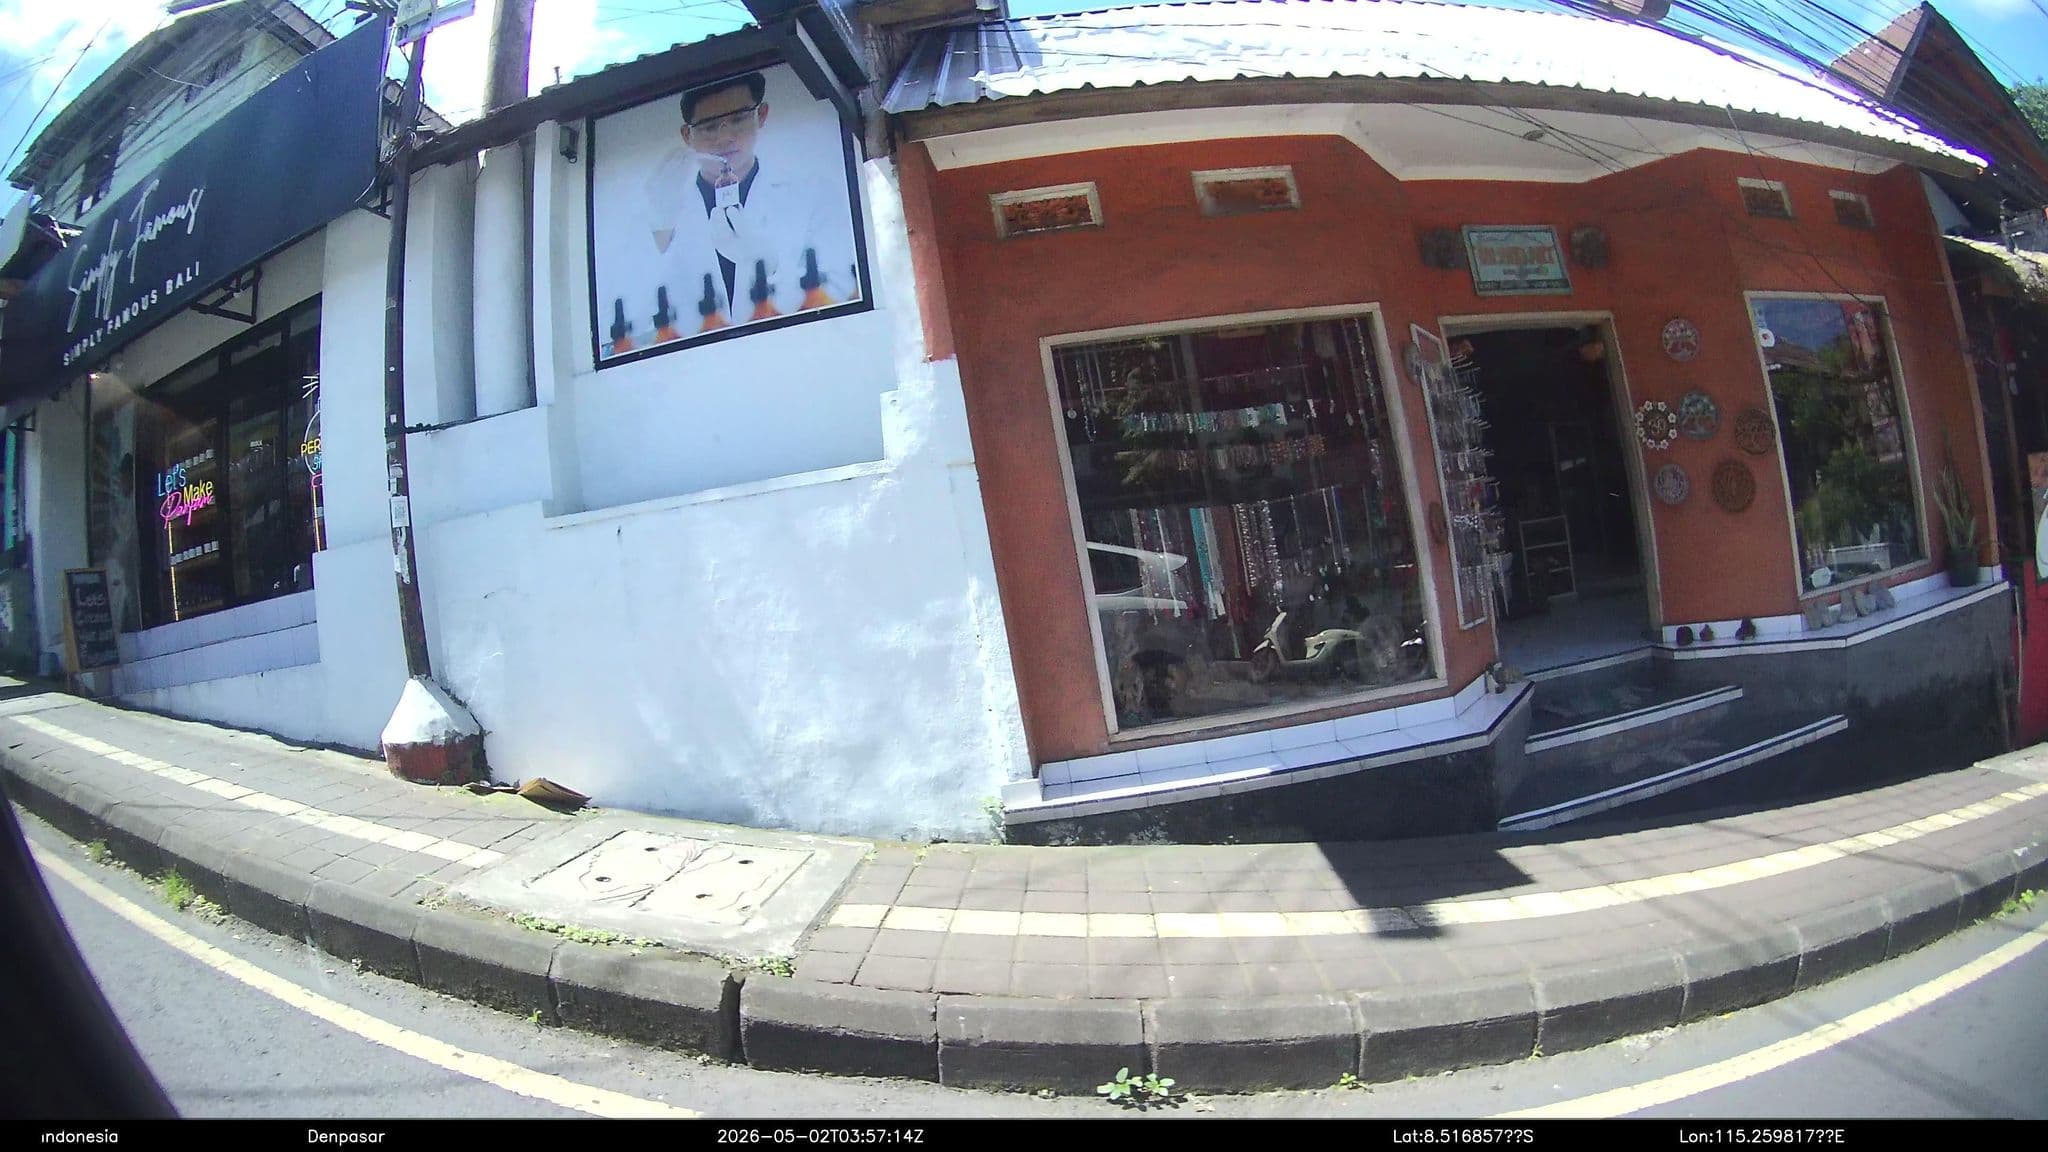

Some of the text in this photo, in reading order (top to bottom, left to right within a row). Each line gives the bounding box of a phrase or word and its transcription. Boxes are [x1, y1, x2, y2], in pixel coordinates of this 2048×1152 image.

[127, 179, 206, 284] Famous
[63, 260, 200, 366] SIMPLY FAMOUS BALI
[157, 463, 187, 497] Let's
[183, 479, 214, 505] Make
